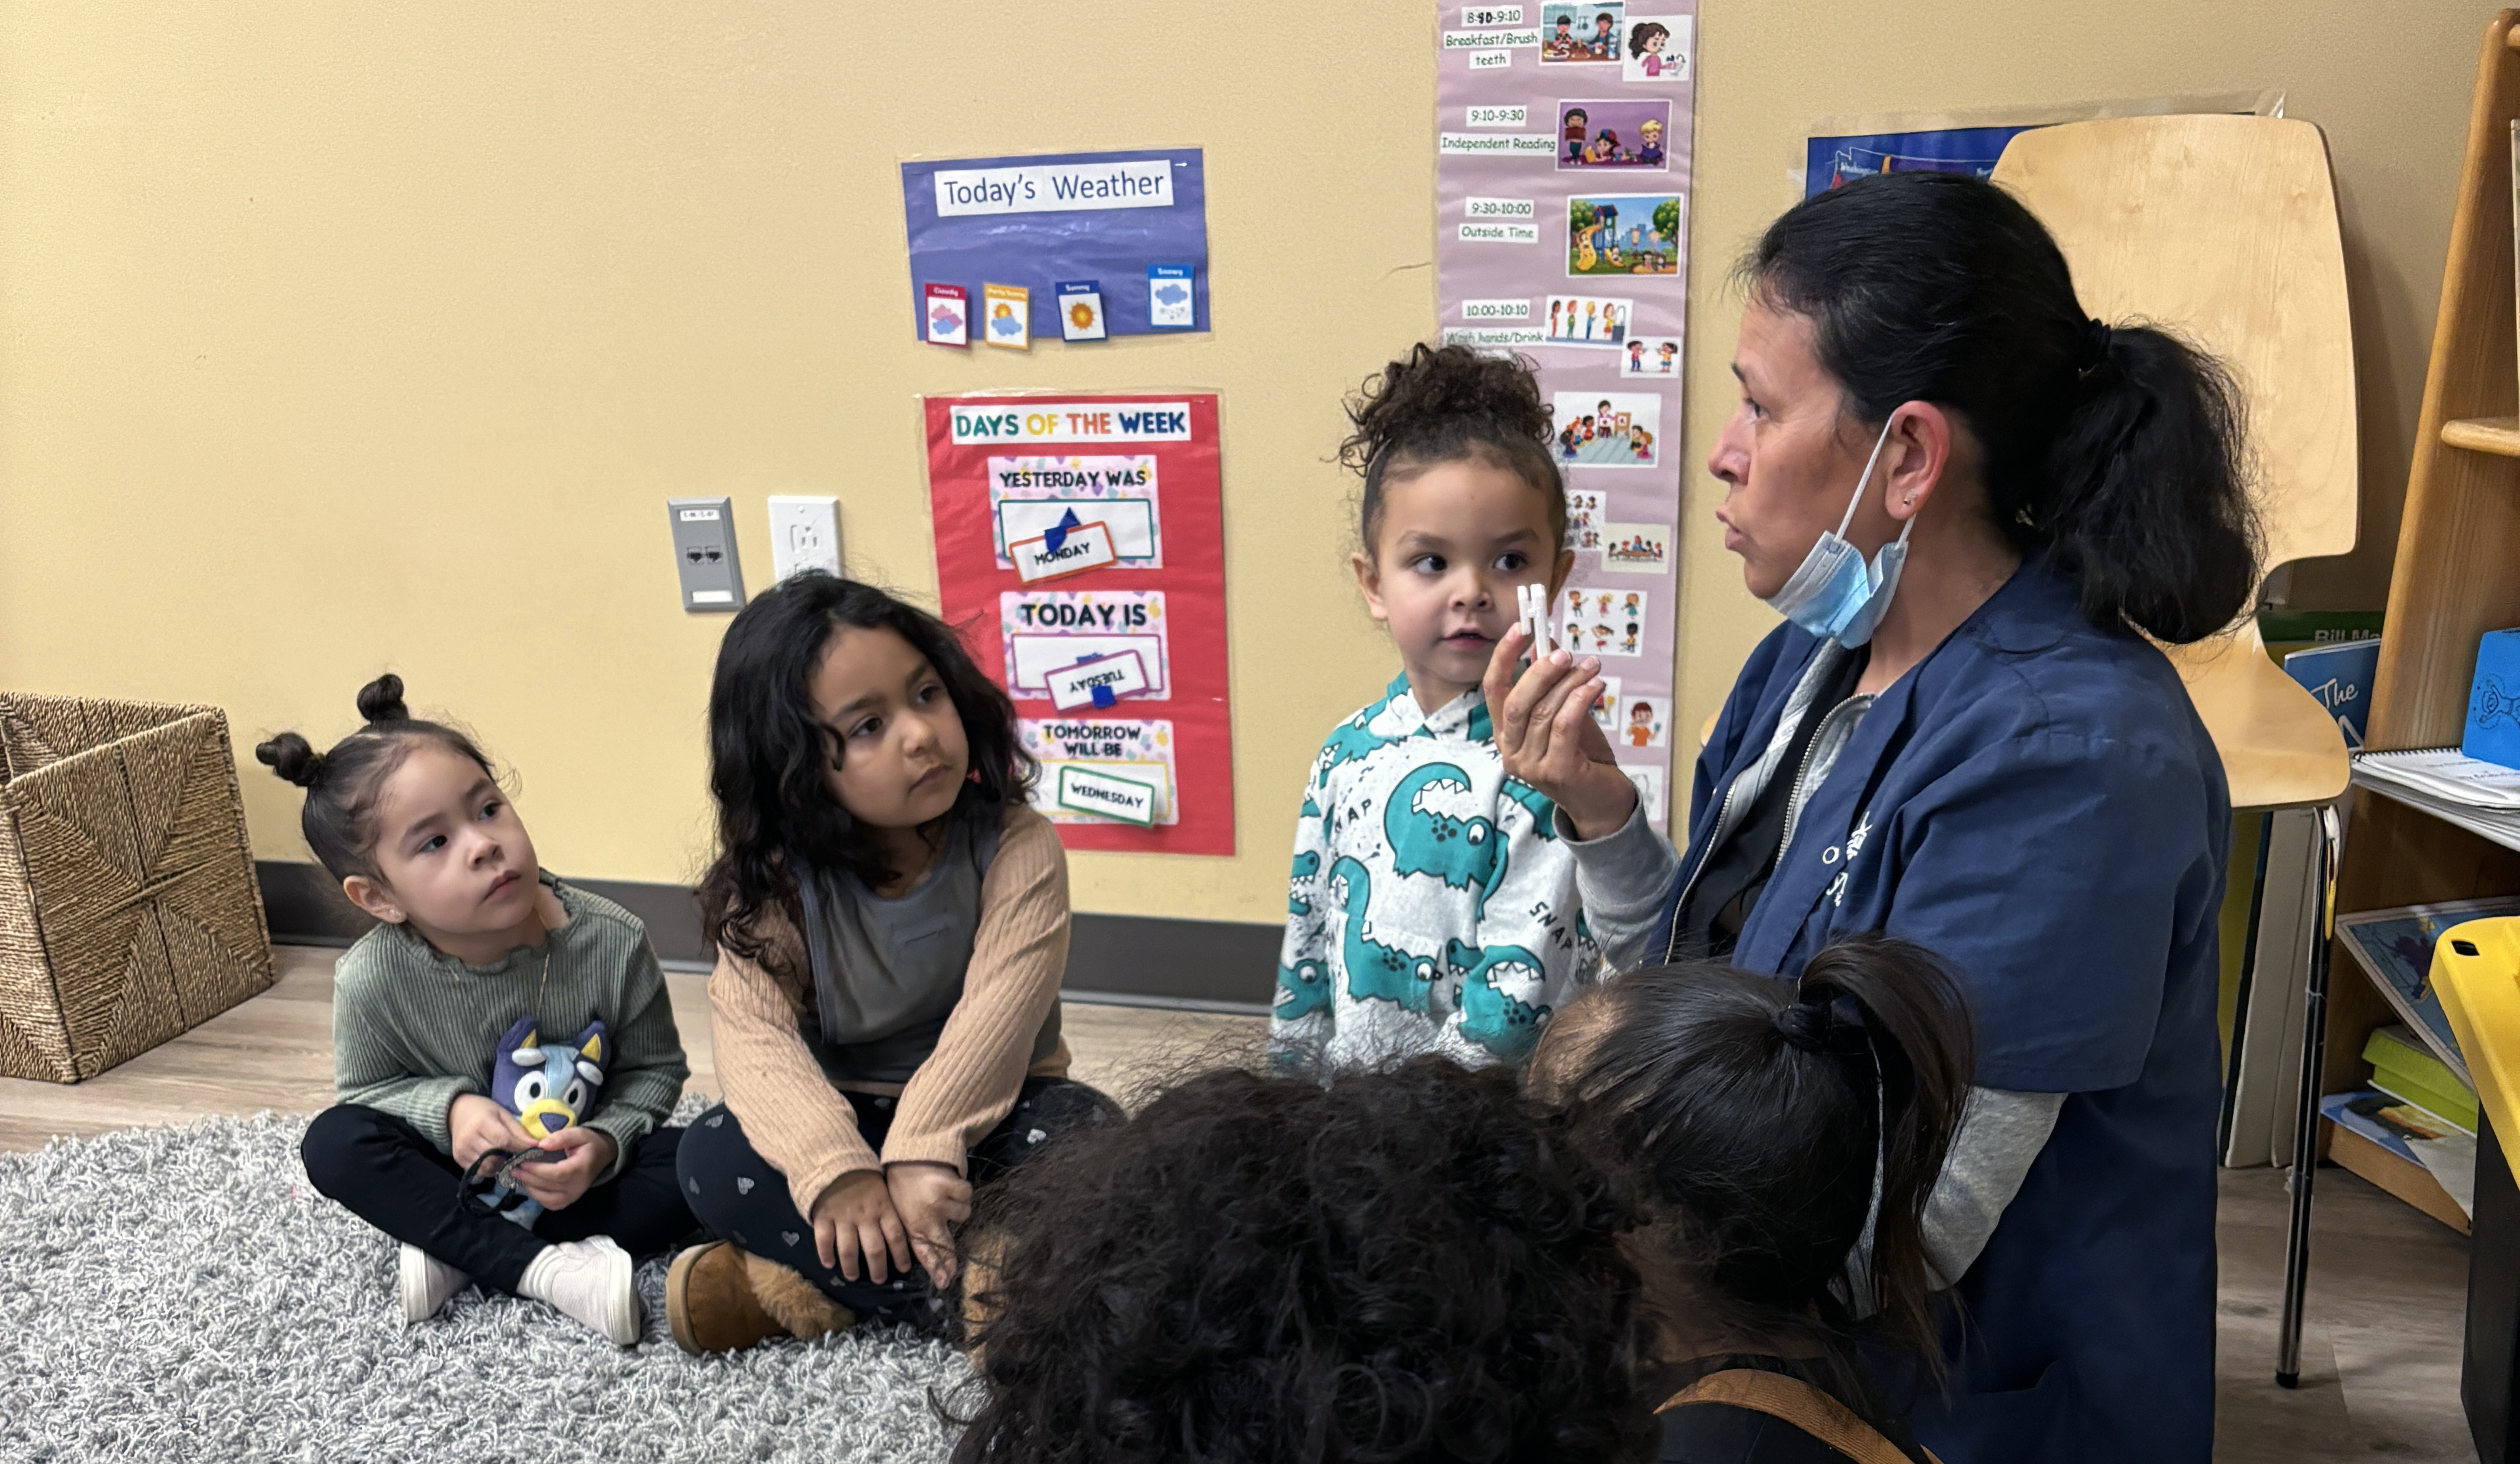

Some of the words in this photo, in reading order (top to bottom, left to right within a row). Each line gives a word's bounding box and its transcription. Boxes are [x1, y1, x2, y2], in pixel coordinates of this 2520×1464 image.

[1446, 32, 1538, 47] Breakfast/Brush
[1475, 54, 1507, 65] teeth
[1471, 109, 1525, 122] 9:10-9:30
[1442, 136, 1510, 151] Independent
[1513, 138, 1556, 152] Reading
[944, 174, 1036, 206] Today's
[1052, 171, 1164, 199] Weather
[1472, 202, 1531, 215] 9:30-10:00
[1461, 226, 1504, 238] Outside
[1508, 226, 1534, 238] Time
[1466, 304, 1528, 316] 10:00-10:10
[1478, 331, 1544, 344] hands/Drink
[955, 413, 1019, 436] DAYS
[1026, 413, 1058, 436] OF
[1066, 412, 1112, 435] THE
[1118, 411, 1185, 433] WEEK
[999, 471, 1099, 487] YESTERDAY
[1105, 470, 1146, 486] WAS
[1034, 542, 1090, 565] MONDAY
[1020, 603, 1115, 627] TODAY
[1124, 603, 1146, 627] IS
[2315, 629, 2346, 642] Bill
[1070, 669, 1126, 693] TUESDAY
[2310, 678, 2359, 709] The
[1044, 725, 1141, 740] TOMORROW
[1064, 742, 1099, 757] WILL
[1102, 742, 1122, 757] BE
[1070, 782, 1144, 808] WEDNESDAY
[1529, 901, 1572, 950] SNAP
